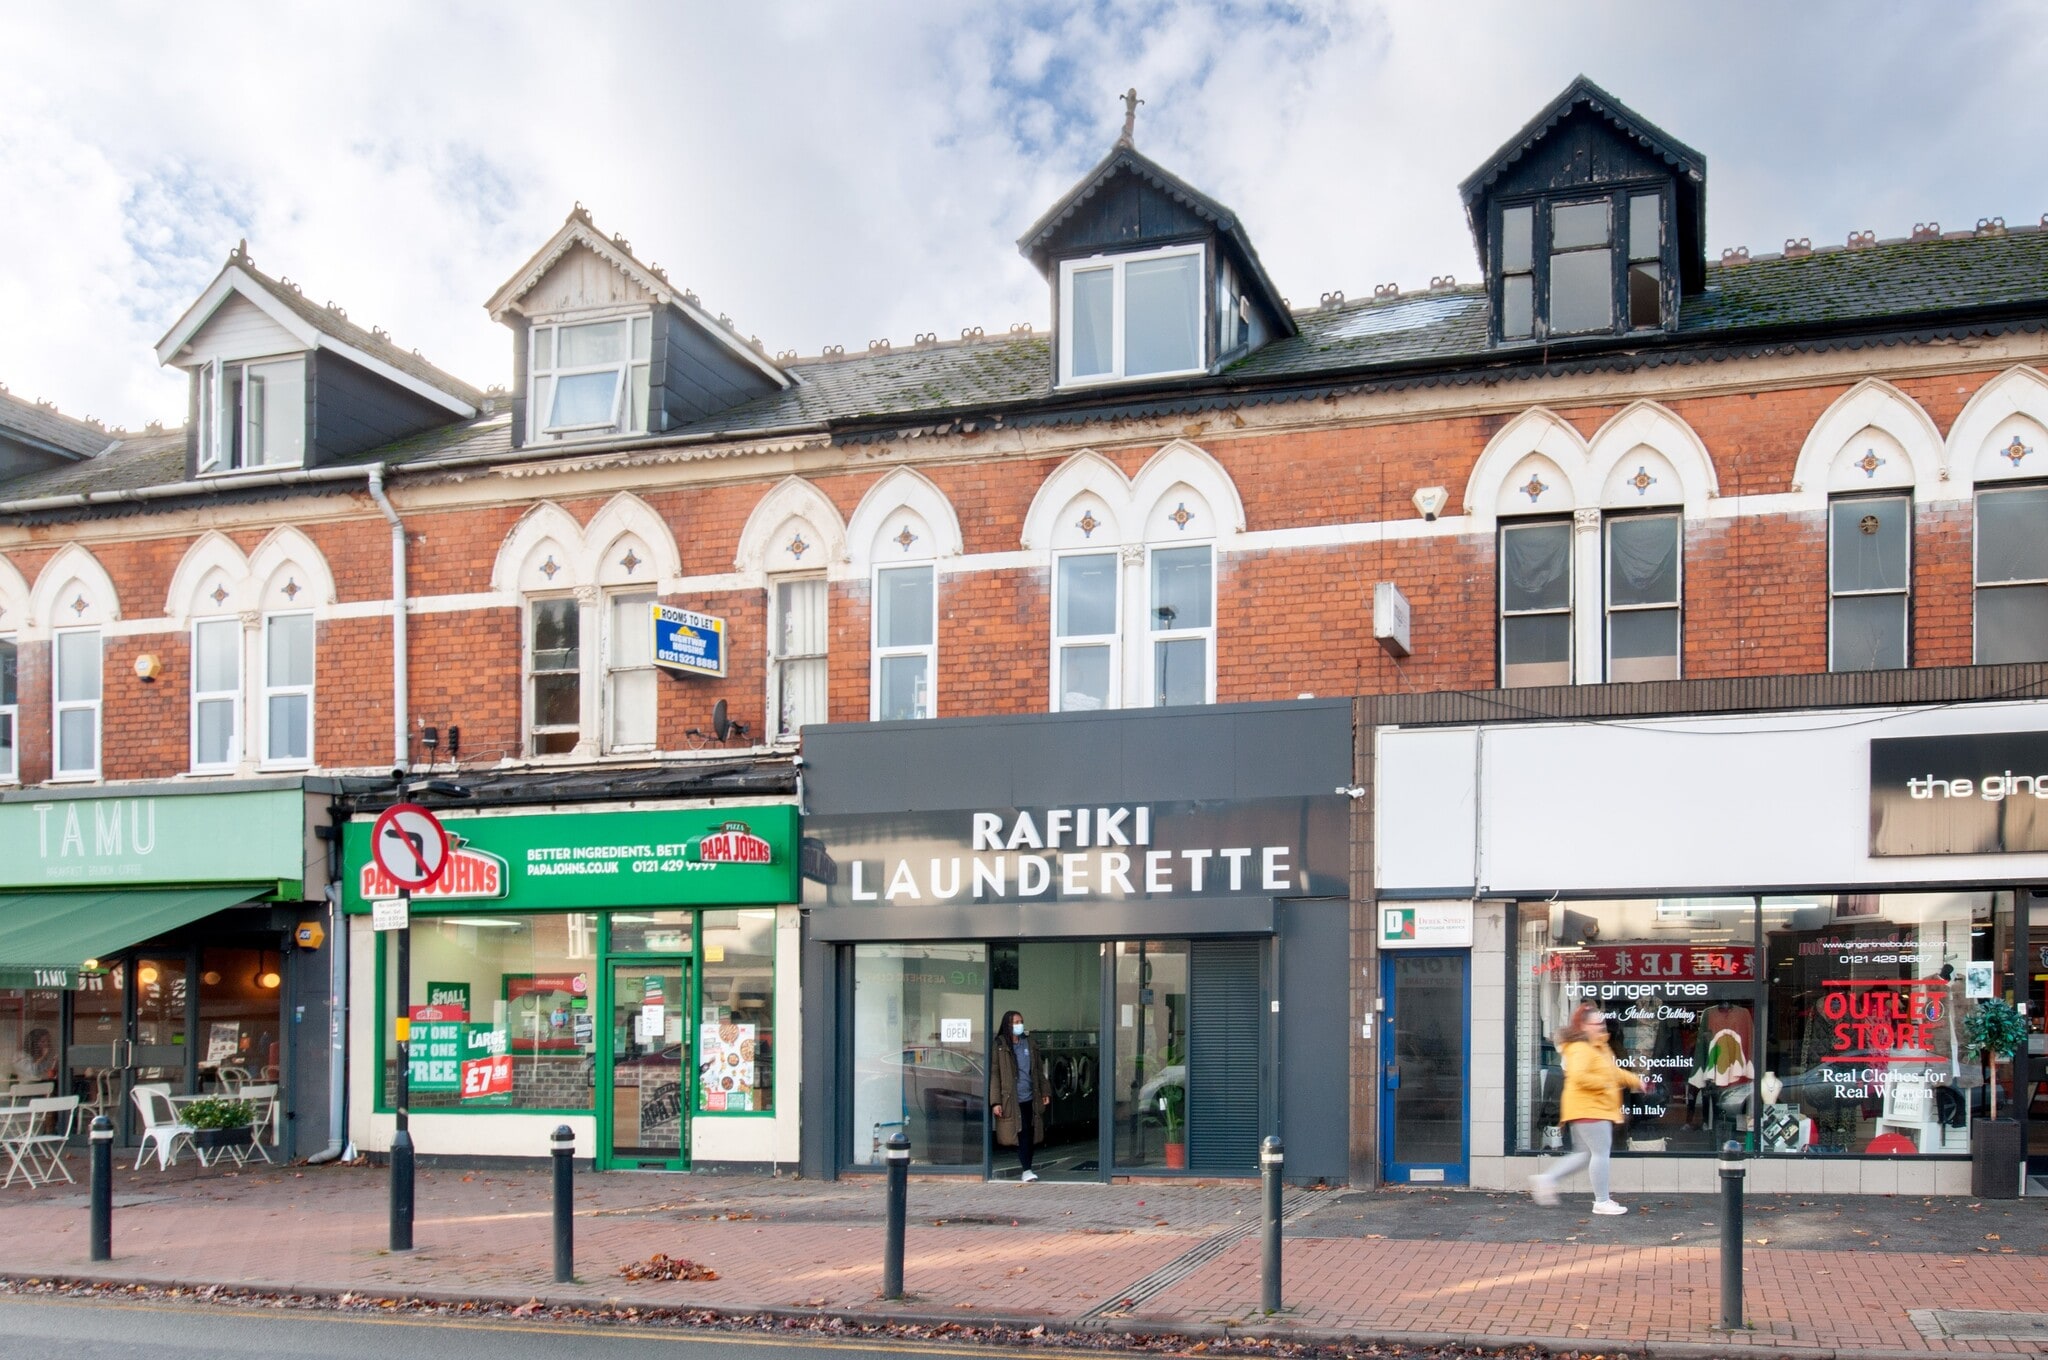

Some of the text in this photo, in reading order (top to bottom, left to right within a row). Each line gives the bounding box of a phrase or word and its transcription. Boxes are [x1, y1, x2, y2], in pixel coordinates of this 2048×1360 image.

[661, 608, 713, 629] ROOMS TO LET
[658, 648, 679, 661] 0121
[1906, 773, 1974, 799] the
[33, 799, 156, 858] TAMU
[725, 823, 745, 831] PIZZA
[972, 806, 1150, 851] RAFIKI
[527, 844, 687, 861] BETTER INGREDIENTS. BETT
[701, 833, 771, 862] PAPA JOHNS
[527, 861, 619, 876] PAPAJOHNS.CO.UK
[632, 860, 659, 873] 0121
[660, 859, 690, 873] 429
[852, 846, 1291, 900] LAUNDERETTE
[1822, 941, 1949, 950] www.gingertreeboutique.com
[1840, 955, 1868, 964] 0121
[1872, 954, 1897, 963] 429
[34, 969, 68, 987] TAMU
[432, 989, 466, 1006] SMALL
[1564, 980, 1708, 1000] the ginger tree
[1618, 1004, 1655, 1022] Italian
[1657, 1005, 1695, 1024] Clothing
[1823, 992, 1947, 1021] OUTLET
[409, 1026, 458, 1040] UY ONE
[467, 1029, 506, 1049] LARGE
[946, 1027, 968, 1039] OPEN
[1833, 1022, 1936, 1051] STORE
[430, 1043, 458, 1057] ONE
[1639, 1055, 1694, 1071] Specialist
[1638, 1073, 1663, 1083] To 26
[1822, 1068, 1947, 1083] Real Clothes for
[1834, 1085, 1869, 1099] Real
[1632, 1104, 1642, 1115] in
[1644, 1104, 1667, 1118] Italy
